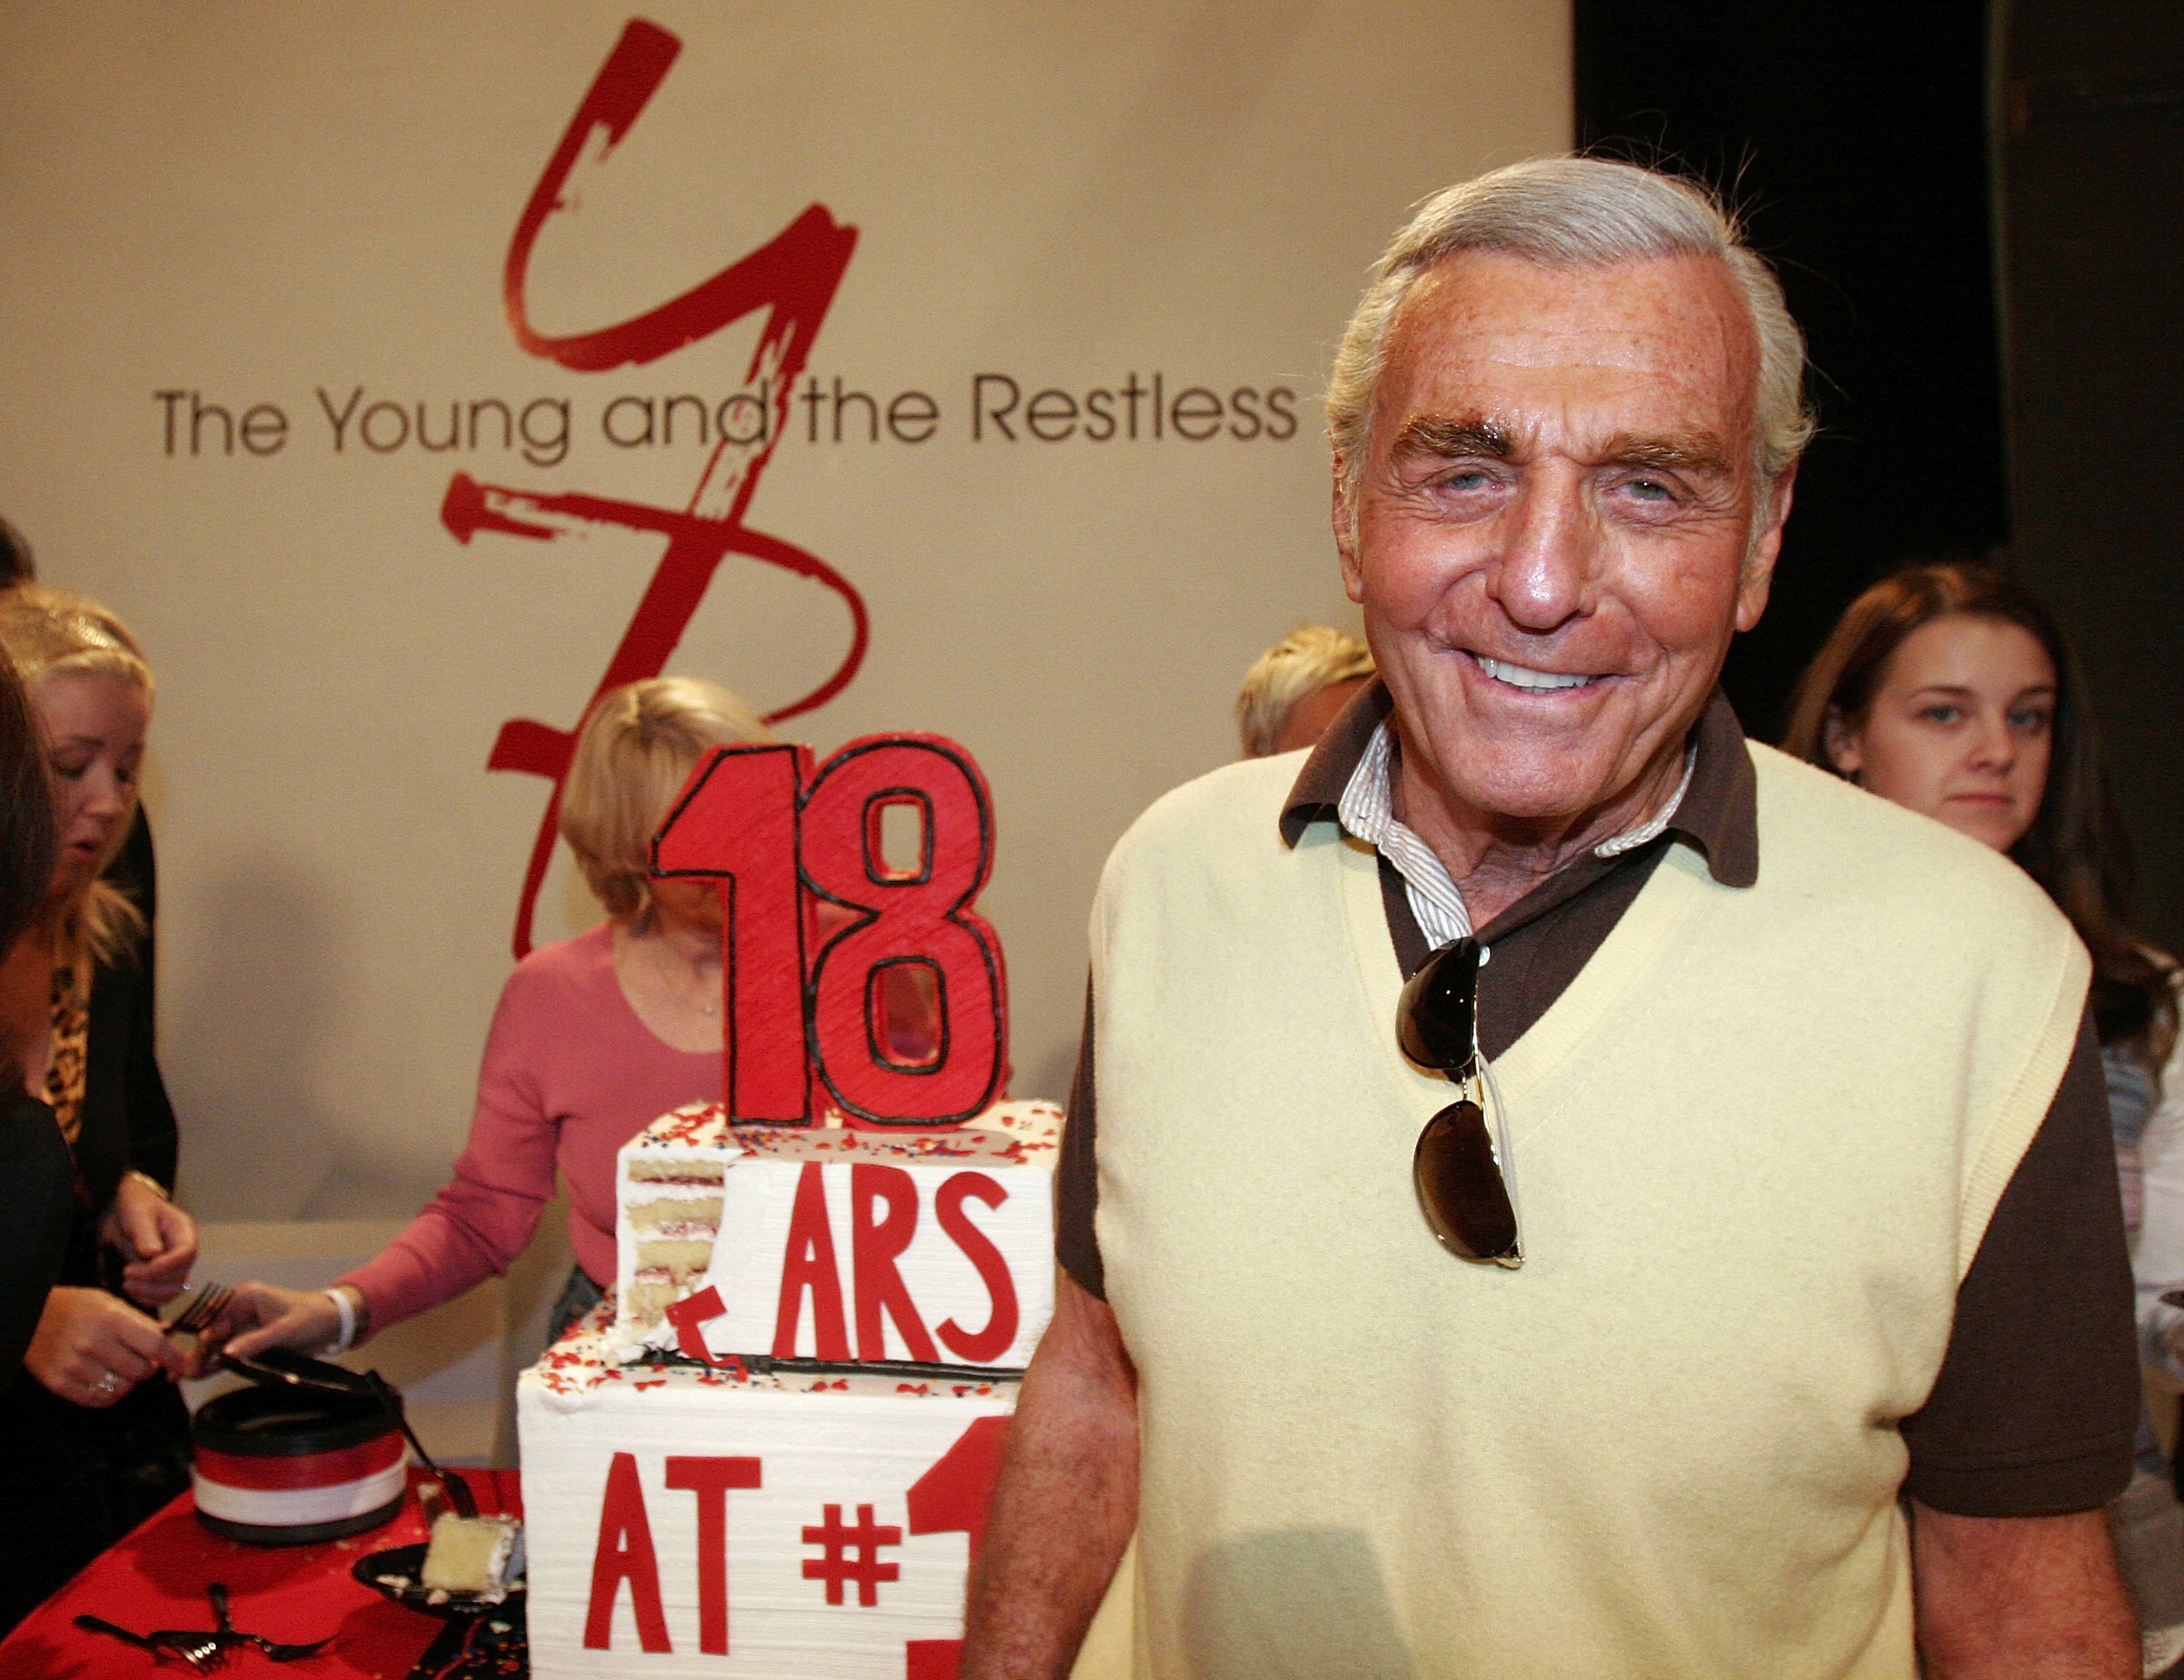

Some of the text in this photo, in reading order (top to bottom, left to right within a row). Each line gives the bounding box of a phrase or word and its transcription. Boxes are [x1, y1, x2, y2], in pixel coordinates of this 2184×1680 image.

[154, 371, 1298, 467] The Young and the Restless
[651, 732, 1010, 1130] 18
[583, 1452, 761, 1655] AT
